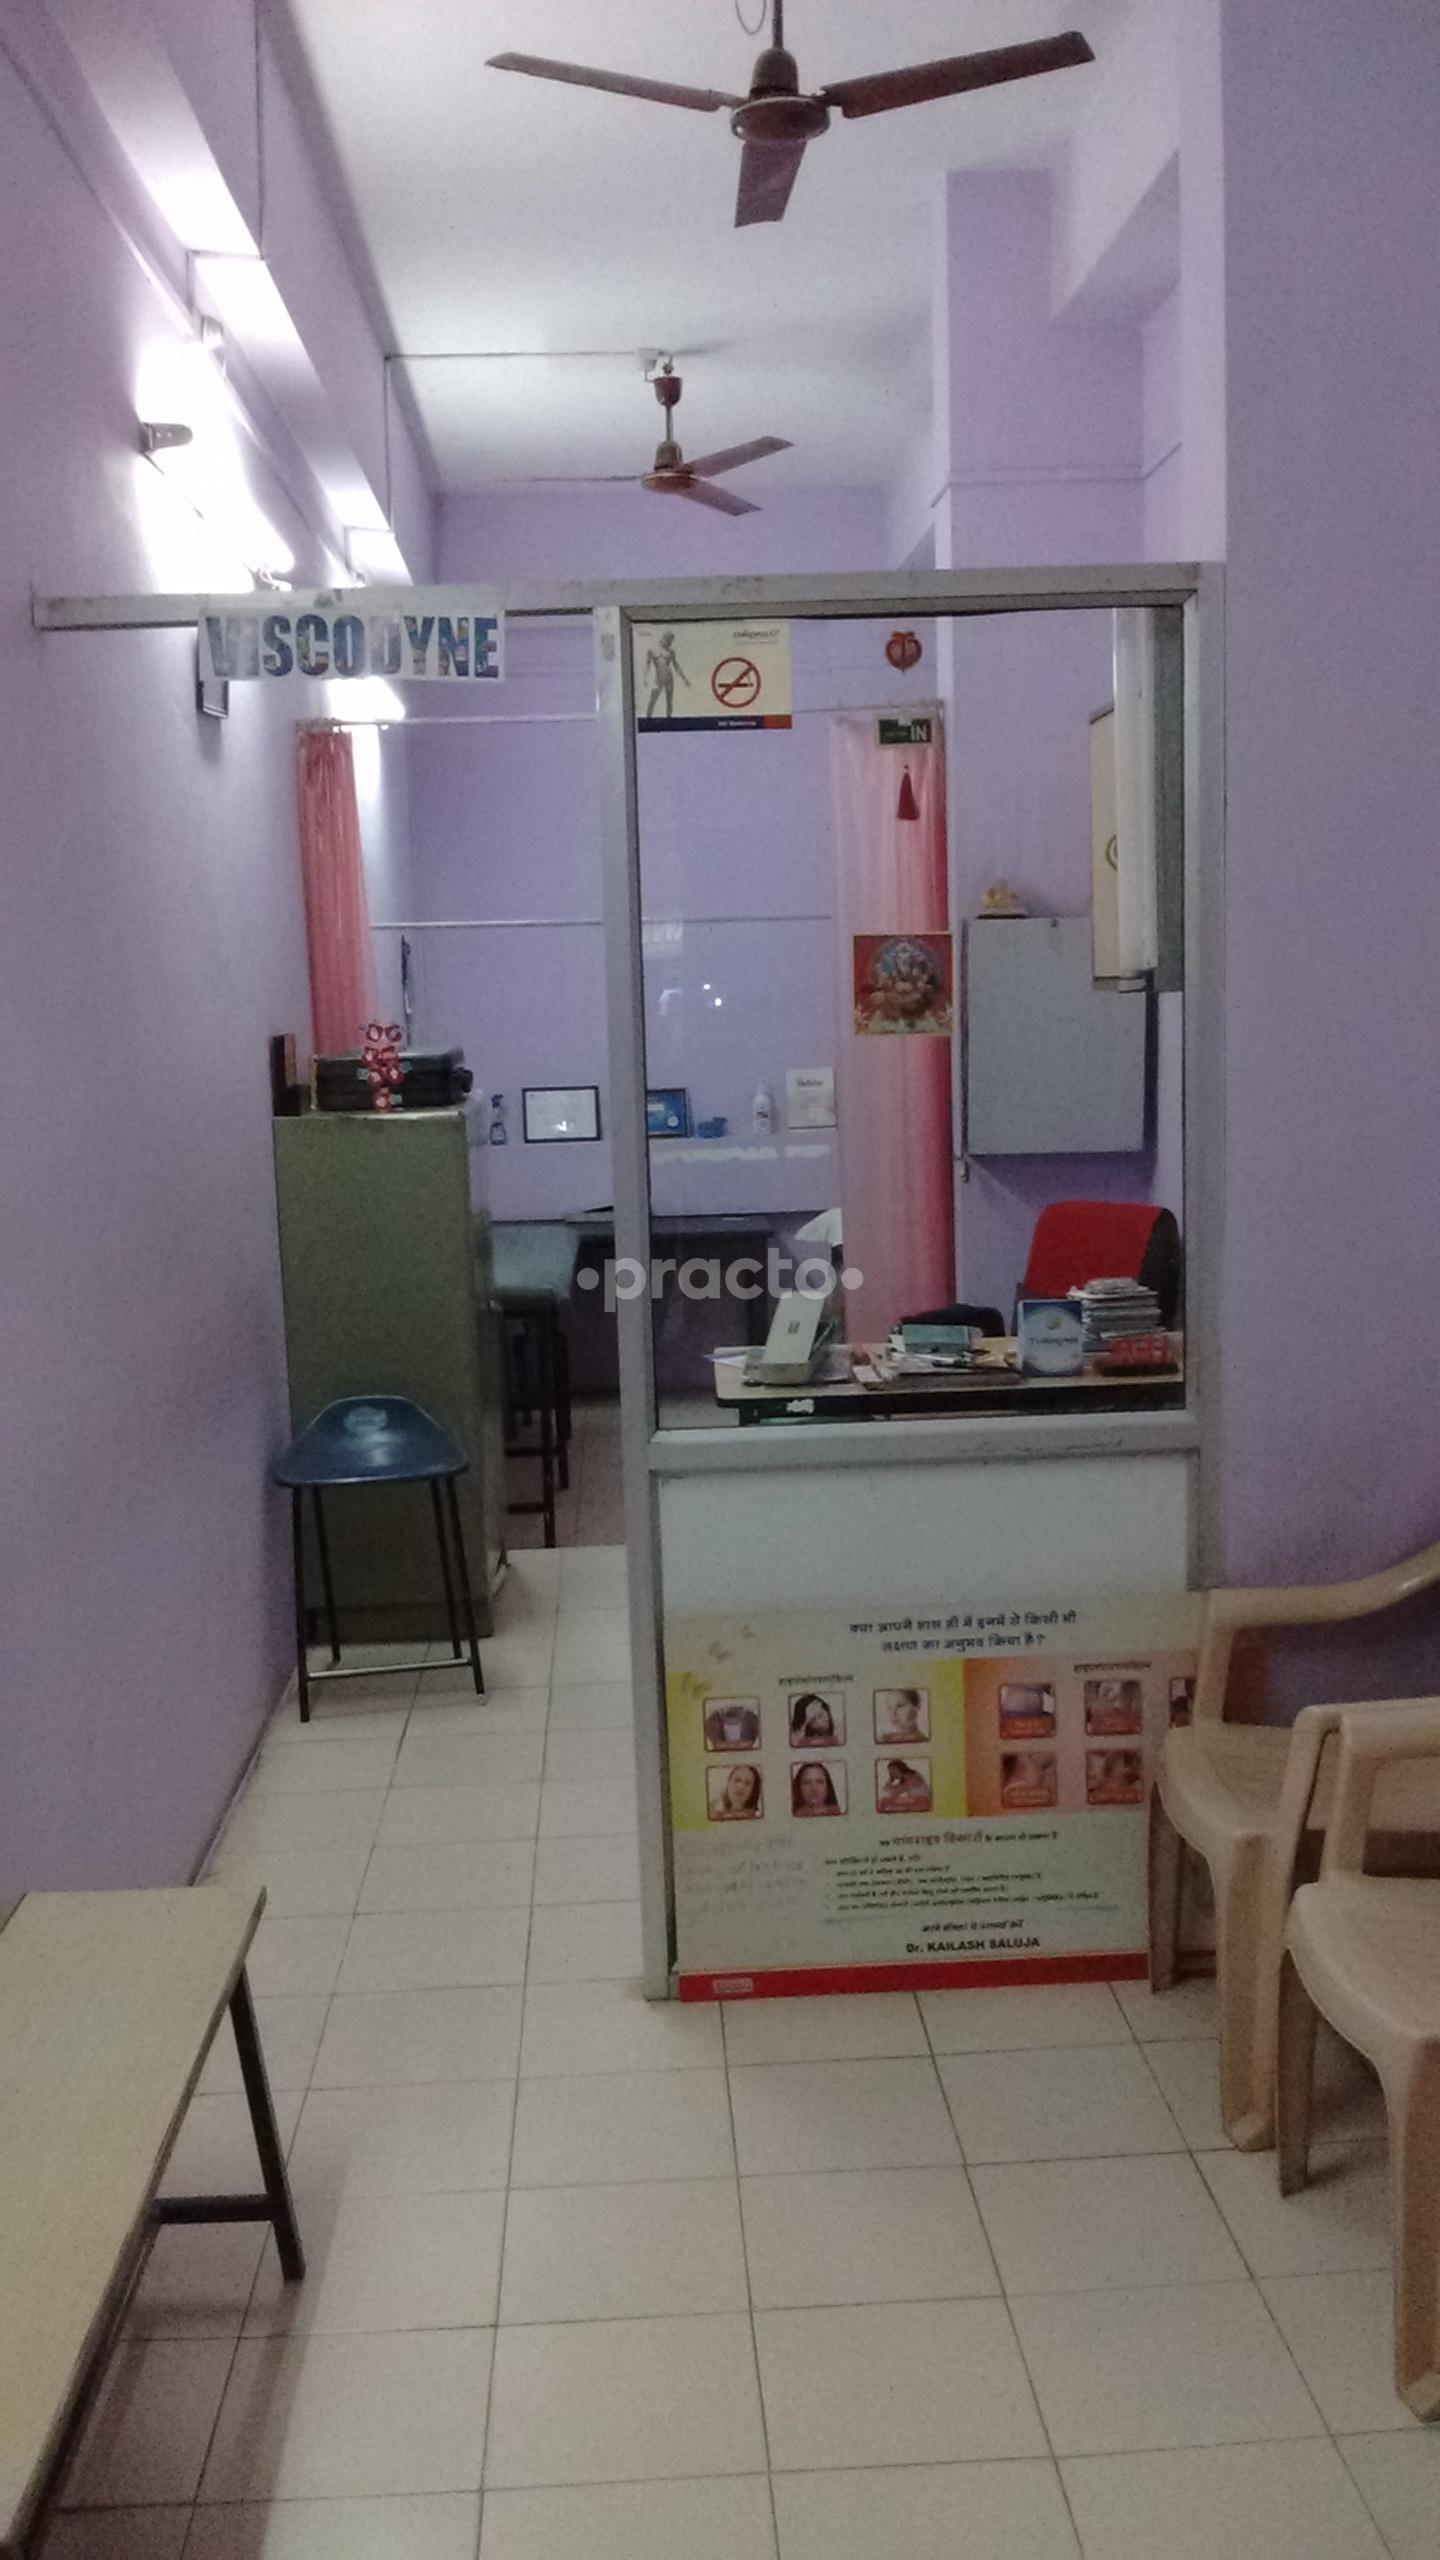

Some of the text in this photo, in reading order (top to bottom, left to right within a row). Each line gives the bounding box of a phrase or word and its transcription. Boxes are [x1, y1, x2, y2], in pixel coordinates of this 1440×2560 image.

[204, 613, 500, 680] VISCODYNE
[910, 724, 927, 741] IN
[945, 1615, 959, 1629] ही
[921, 1638, 940, 1650] का
[905, 1936, 1041, 1954] Dr. KAILASH SALUJA
